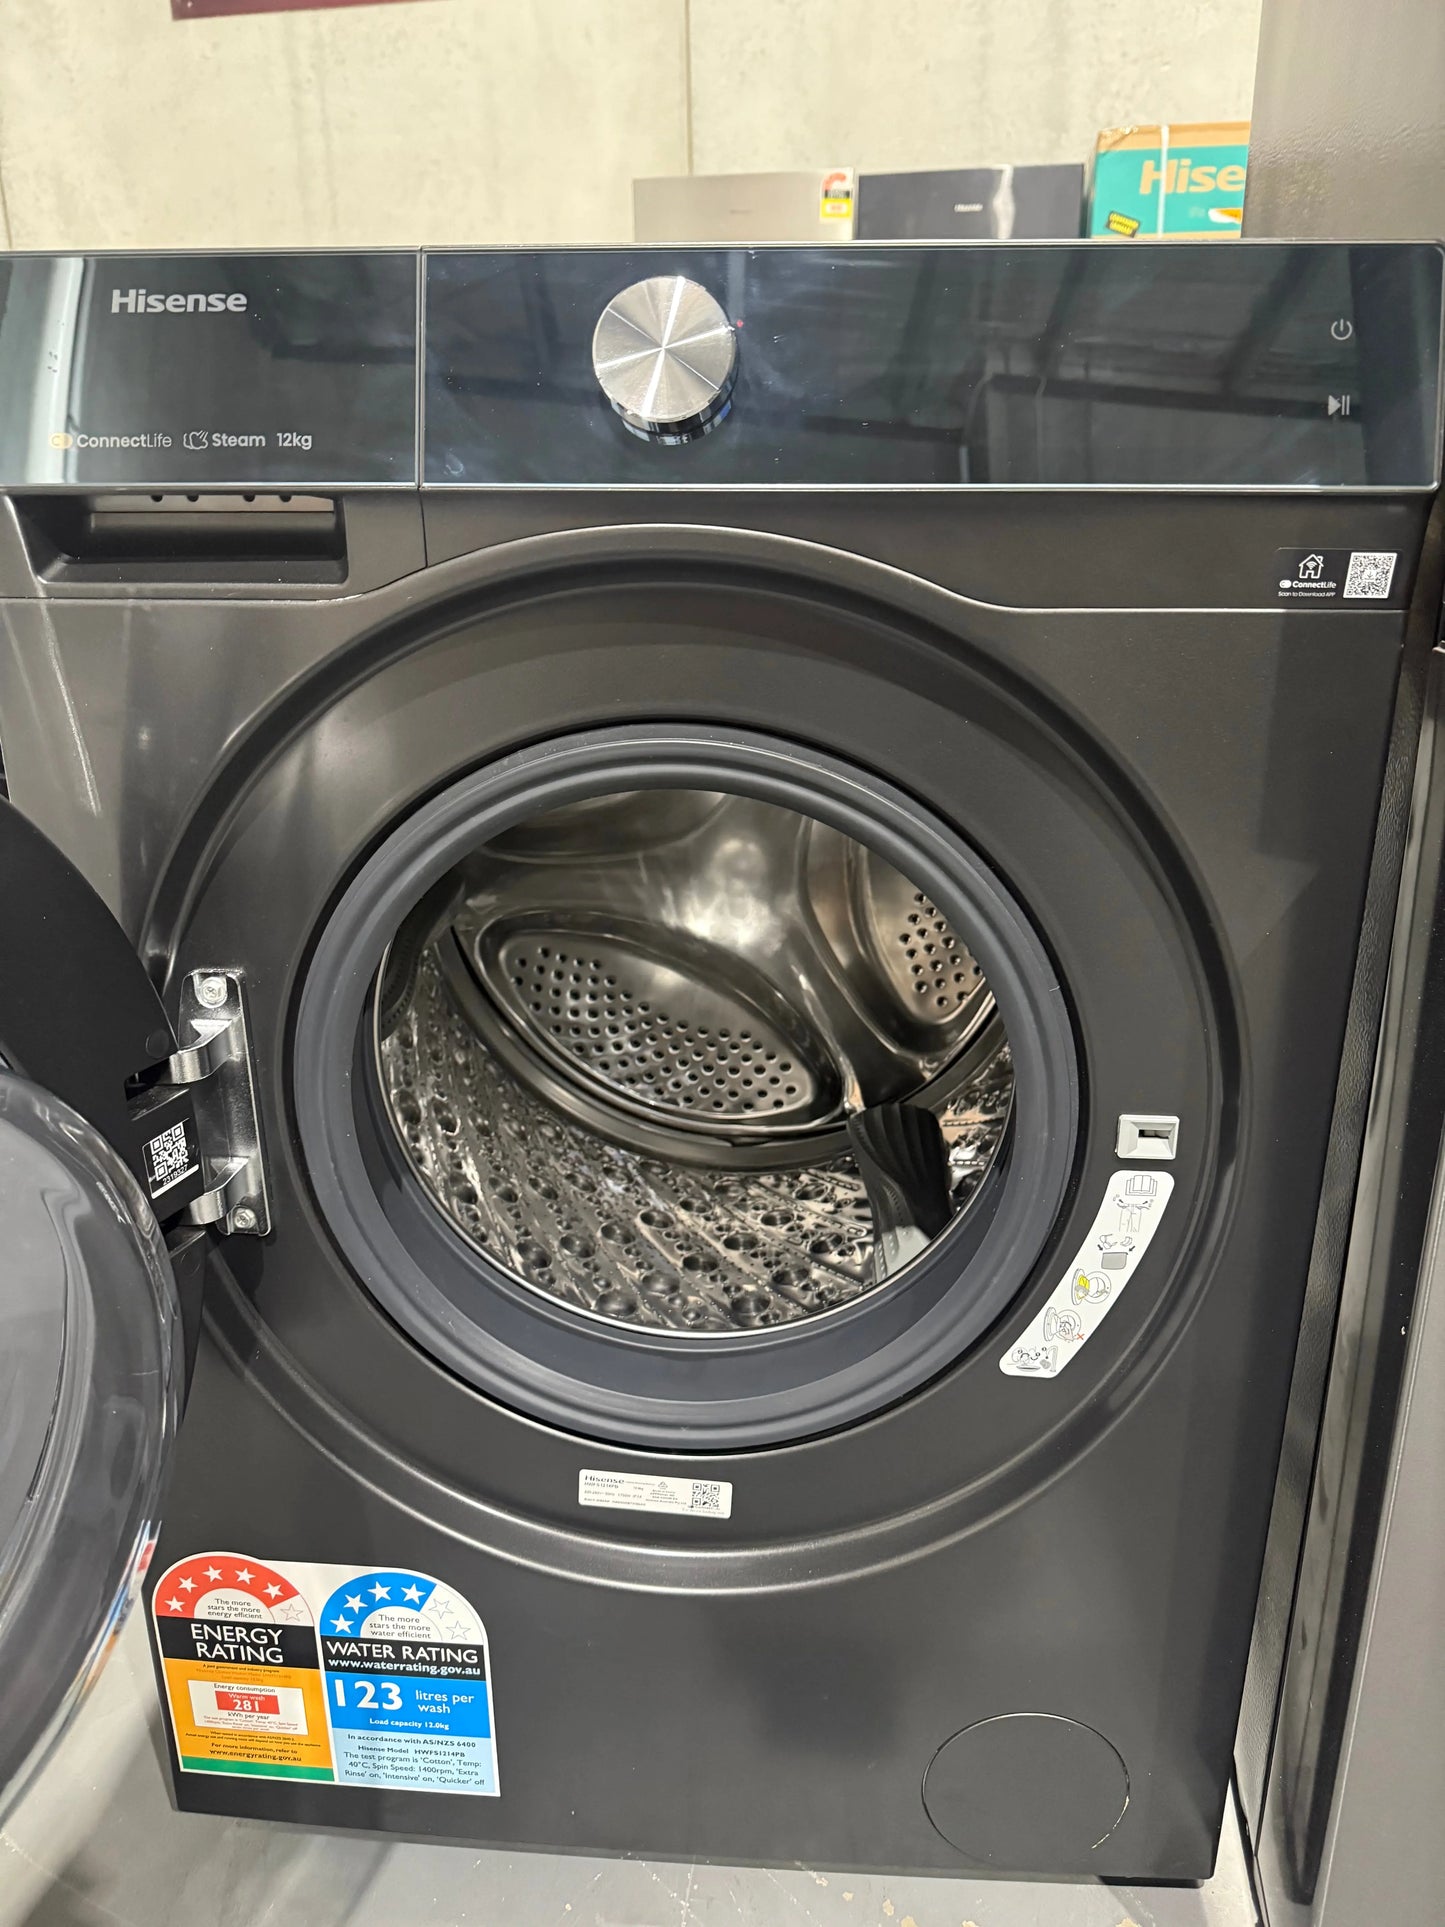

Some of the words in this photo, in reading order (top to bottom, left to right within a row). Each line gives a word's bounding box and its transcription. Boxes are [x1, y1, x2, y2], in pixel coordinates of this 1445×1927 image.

[111, 288, 248, 314] Hisense
[76, 433, 172, 449] ConnectLife
[212, 433, 266, 448] Steam
[276, 433, 313, 450] 12kg
[1292, 580, 1337, 589] ConnectLife
[584, 1475, 625, 1485] Hisense
[214, 1598, 229, 1606] The
[378, 1614, 395, 1622] The
[397, 1616, 420, 1624] more
[190, 1623, 283, 1645] ENERGY
[397, 1631, 431, 1639] efficient
[196, 1642, 284, 1663] RATING
[326, 1640, 396, 1659] WATER
[402, 1645, 478, 1663] RATING
[328, 1658, 480, 1675] www.waterrating.gov.au
[213, 1683, 235, 1691] Energy
[235, 1685, 276, 1693] consumption
[334, 1679, 403, 1711] 123
[415, 1690, 448, 1702] litres
[452, 1693, 475, 1705] per
[233, 1699, 260, 1712] 281
[418, 1703, 450, 1714] wash
[390, 1720, 422, 1729] capacity
[424, 1722, 449, 1730] 12.0kg
[357, 1734, 402, 1743] accordance
[423, 1739, 455, 1747] AS/NZS
[209, 1749, 302, 1762] www.energyrating.gov.au
[344, 1751, 359, 1759] The
[378, 1755, 411, 1764] program
[457, 1760, 482, 1768] Temp:
[372, 1763, 389, 1771] Spin
[391, 1764, 416, 1773] Speed:
[418, 1766, 454, 1776] 1400rpm,
